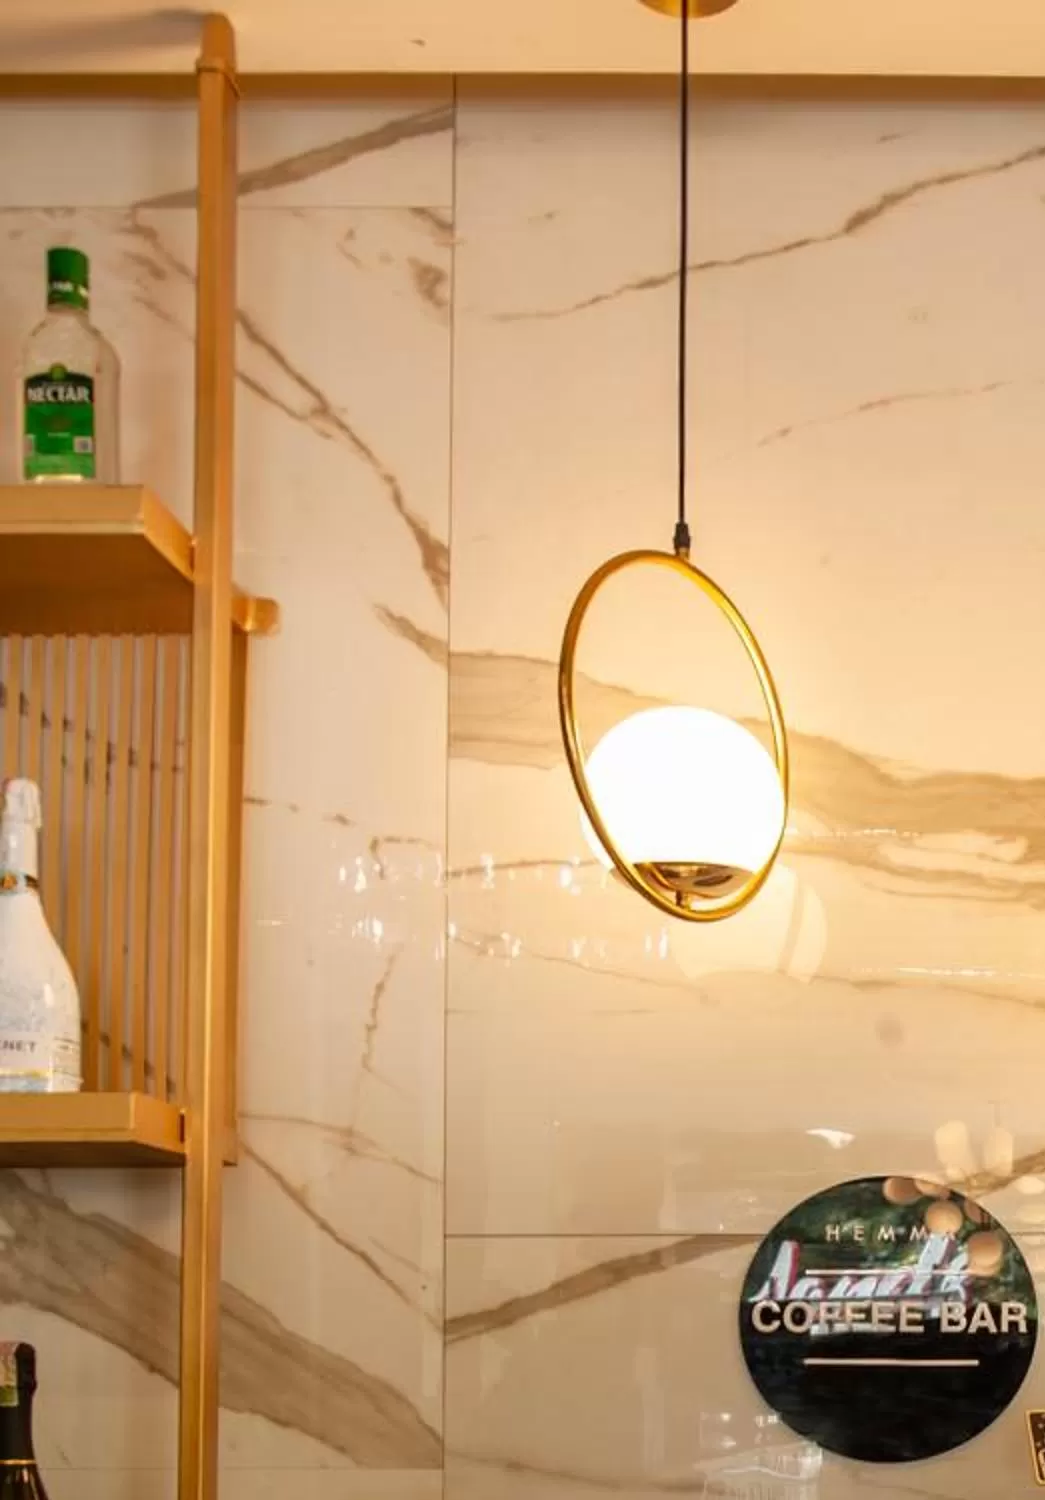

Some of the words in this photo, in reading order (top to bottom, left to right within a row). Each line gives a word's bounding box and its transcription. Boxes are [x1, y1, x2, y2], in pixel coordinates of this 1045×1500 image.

[27, 384, 90, 402] NECTAR
[0, 1039, 38, 1053] NET
[751, 1301, 925, 1333] COFFEE
[939, 1301, 1028, 1333] BAR
